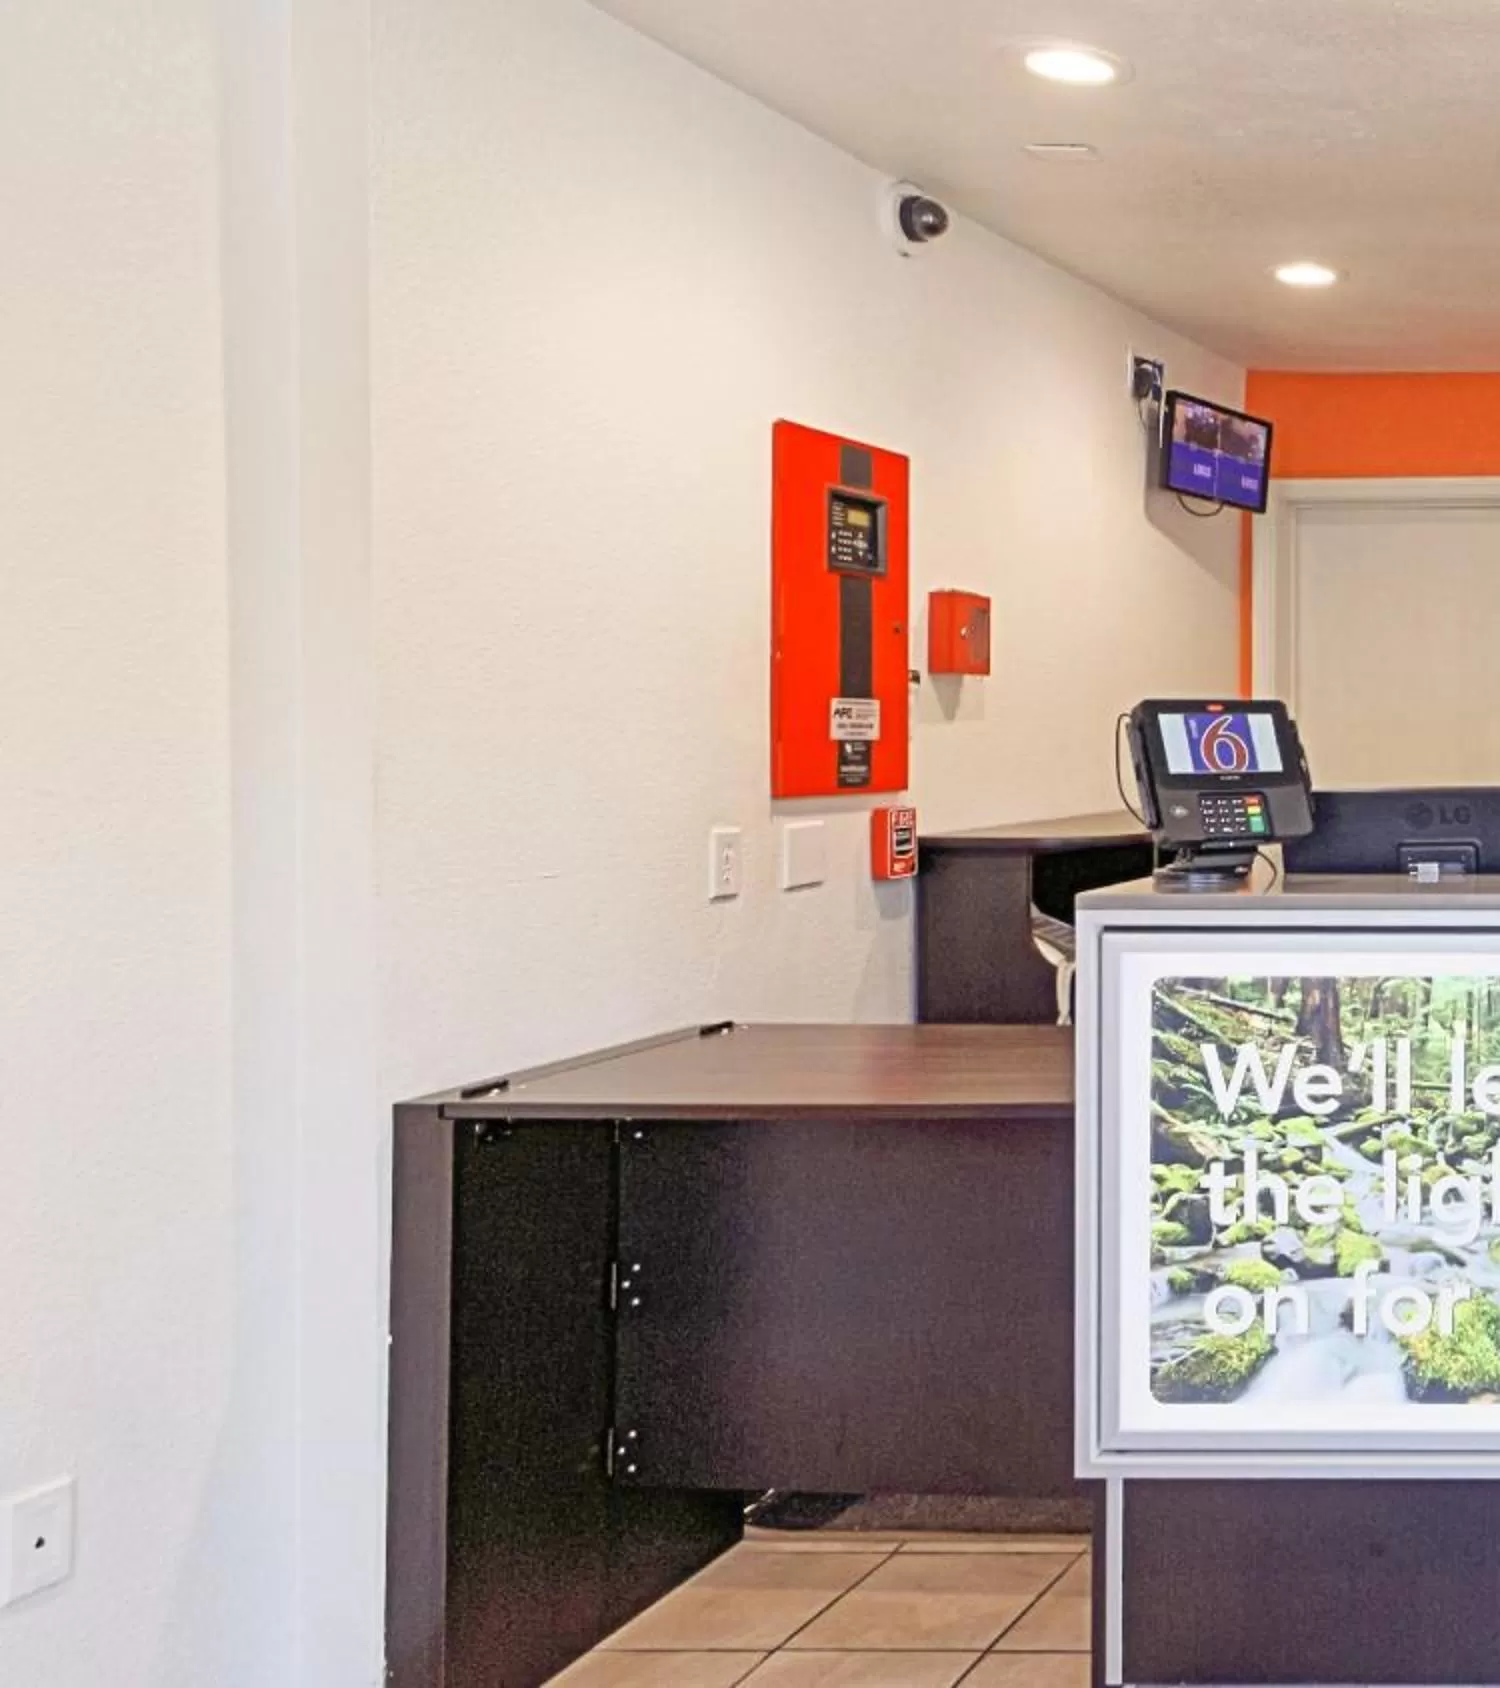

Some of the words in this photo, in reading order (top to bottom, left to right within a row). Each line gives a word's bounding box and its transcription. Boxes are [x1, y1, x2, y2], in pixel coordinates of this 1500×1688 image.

[1199, 714, 1249, 773] 6
[1439, 803, 1471, 825] LG
[1200, 1037, 1412, 1116] We'll
[1199, 1138, 1345, 1227] the
[1203, 1283, 1311, 1336] on
[1352, 1258, 1474, 1336] for
